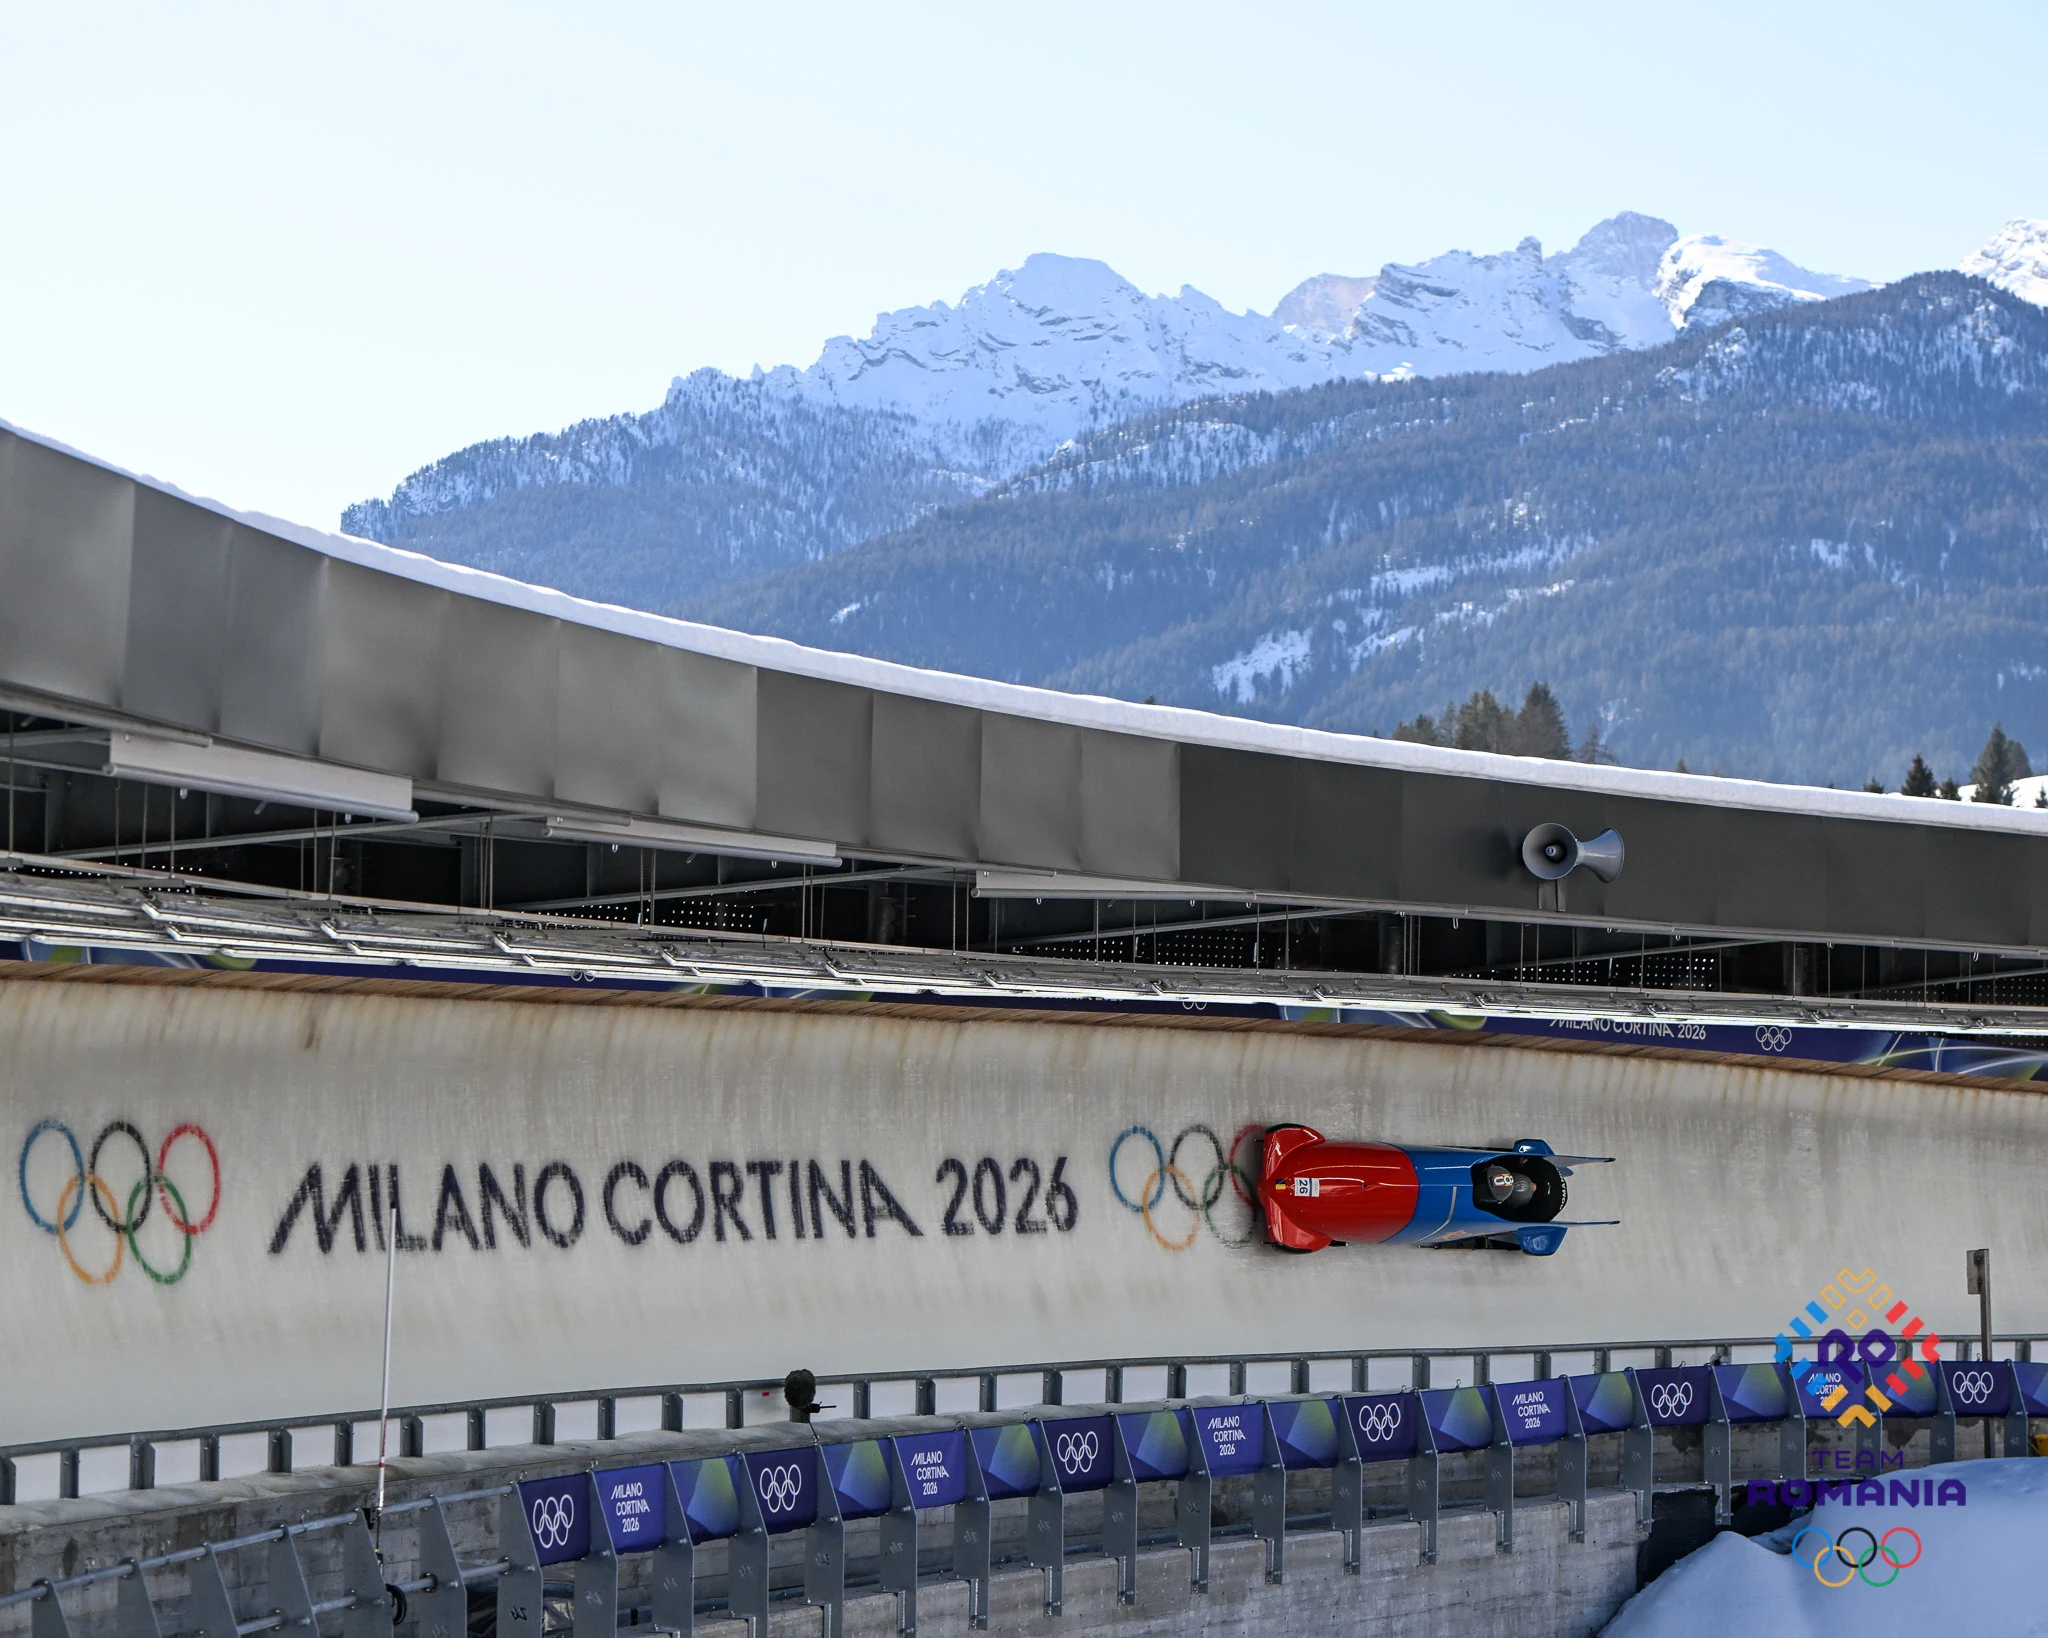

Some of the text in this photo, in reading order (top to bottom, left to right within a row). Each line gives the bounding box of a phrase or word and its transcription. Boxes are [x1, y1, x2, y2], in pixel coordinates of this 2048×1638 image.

[1613, 1022, 1674, 1038] CORTINA
[1677, 1024, 1706, 1040] 2026
[1299, 1179, 1308, 1194] 26
[268, 1156, 1079, 1255] MILANO CORTINA 2026
[1512, 1391, 1544, 1405] MILANO
[1518, 1404, 1551, 1417] CORTINA
[1207, 1416, 1240, 1430] MILANO
[1525, 1417, 1541, 1429] 2026
[1213, 1429, 1246, 1442] CORTINA
[1219, 1444, 1236, 1456] 2026
[911, 1450, 943, 1466] MILANO
[916, 1465, 950, 1480] CORTINA
[610, 1482, 643, 1499] MILANO
[922, 1481, 938, 1496] 2026
[615, 1499, 650, 1516] CORTINA
[622, 1517, 640, 1532] 2026
